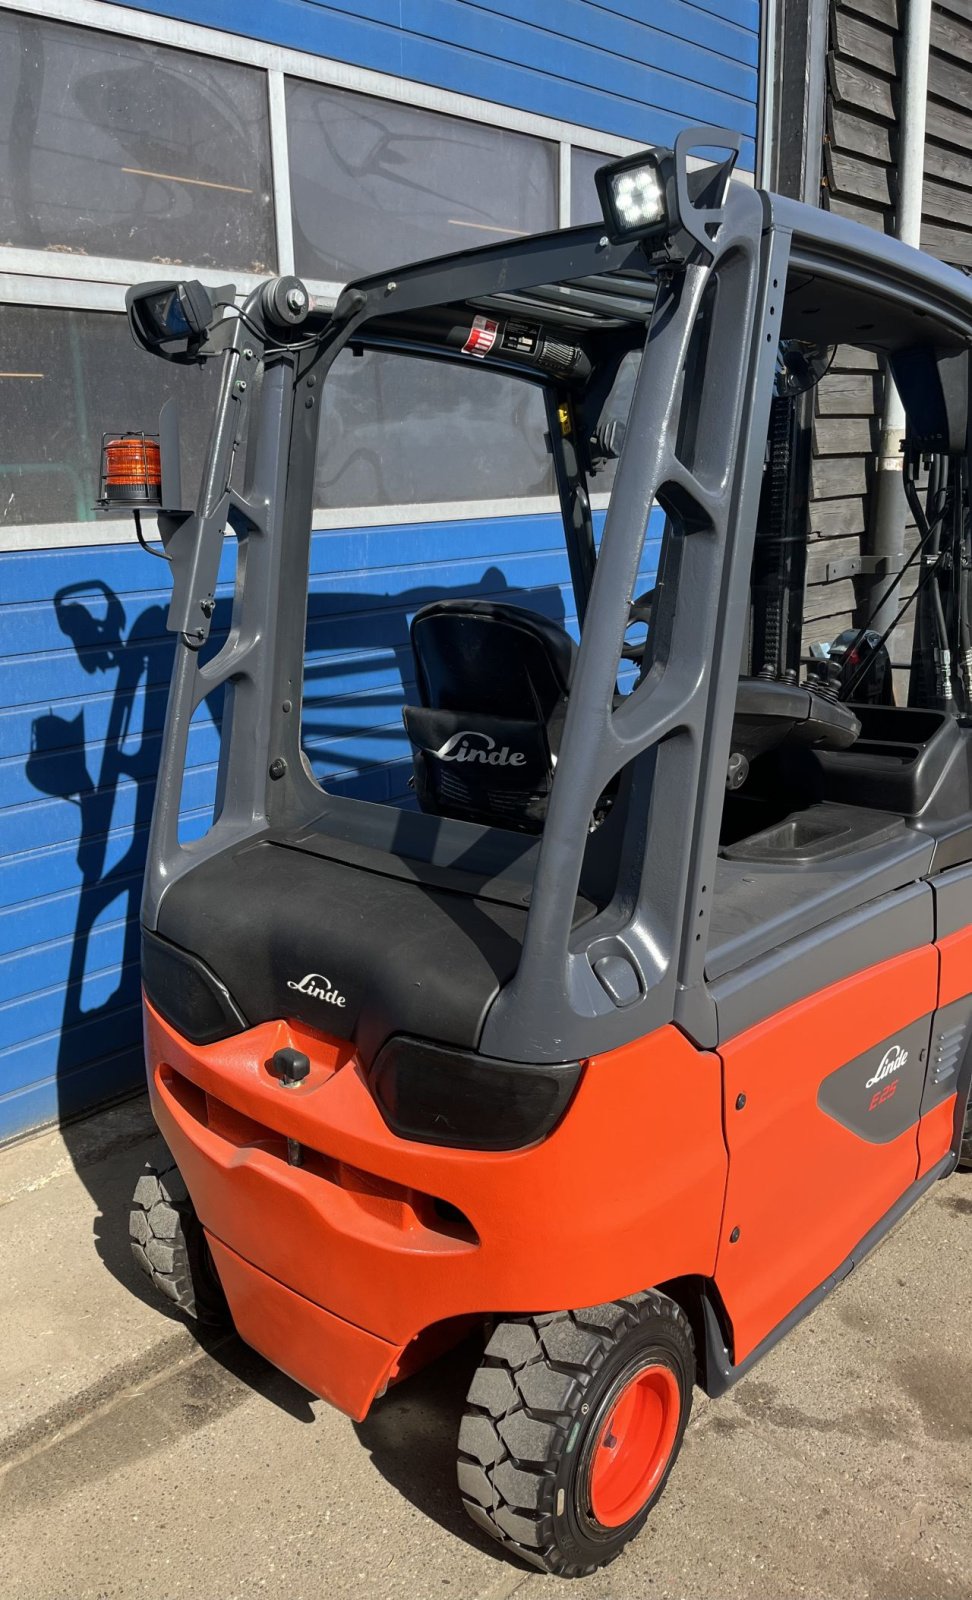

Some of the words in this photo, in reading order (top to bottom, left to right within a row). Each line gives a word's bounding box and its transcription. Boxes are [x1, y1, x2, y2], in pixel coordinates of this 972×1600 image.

[428, 731, 527, 766] Linde
[287, 973, 346, 1008] Linde
[865, 1045, 909, 1089] Linde
[868, 1079, 899, 1111] E25
